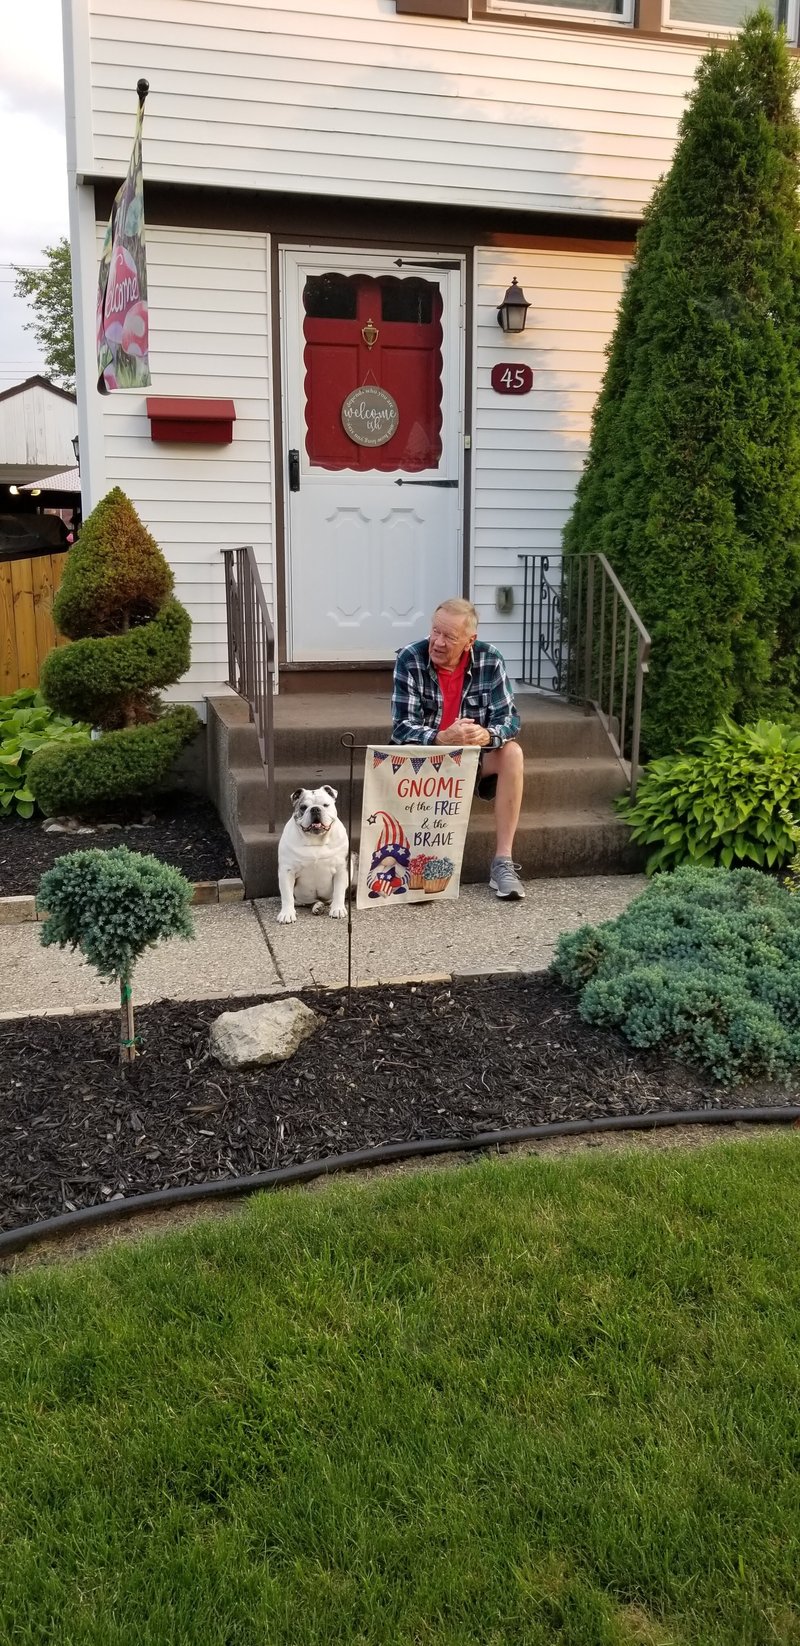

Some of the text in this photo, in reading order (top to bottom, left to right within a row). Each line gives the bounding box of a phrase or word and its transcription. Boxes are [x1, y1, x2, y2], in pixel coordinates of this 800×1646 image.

[104, 277, 139, 319] elcome
[500, 368, 525, 389] 45
[347, 390, 365, 407] depends
[377, 391, 388, 400] you
[344, 401, 396, 420] welcome
[366, 416, 382, 432] ish
[397, 776, 465, 798] GNOME
[405, 800, 461, 816] of the FREE
[421, 817, 448, 830] & the
[413, 831, 455, 847] BRAVE
